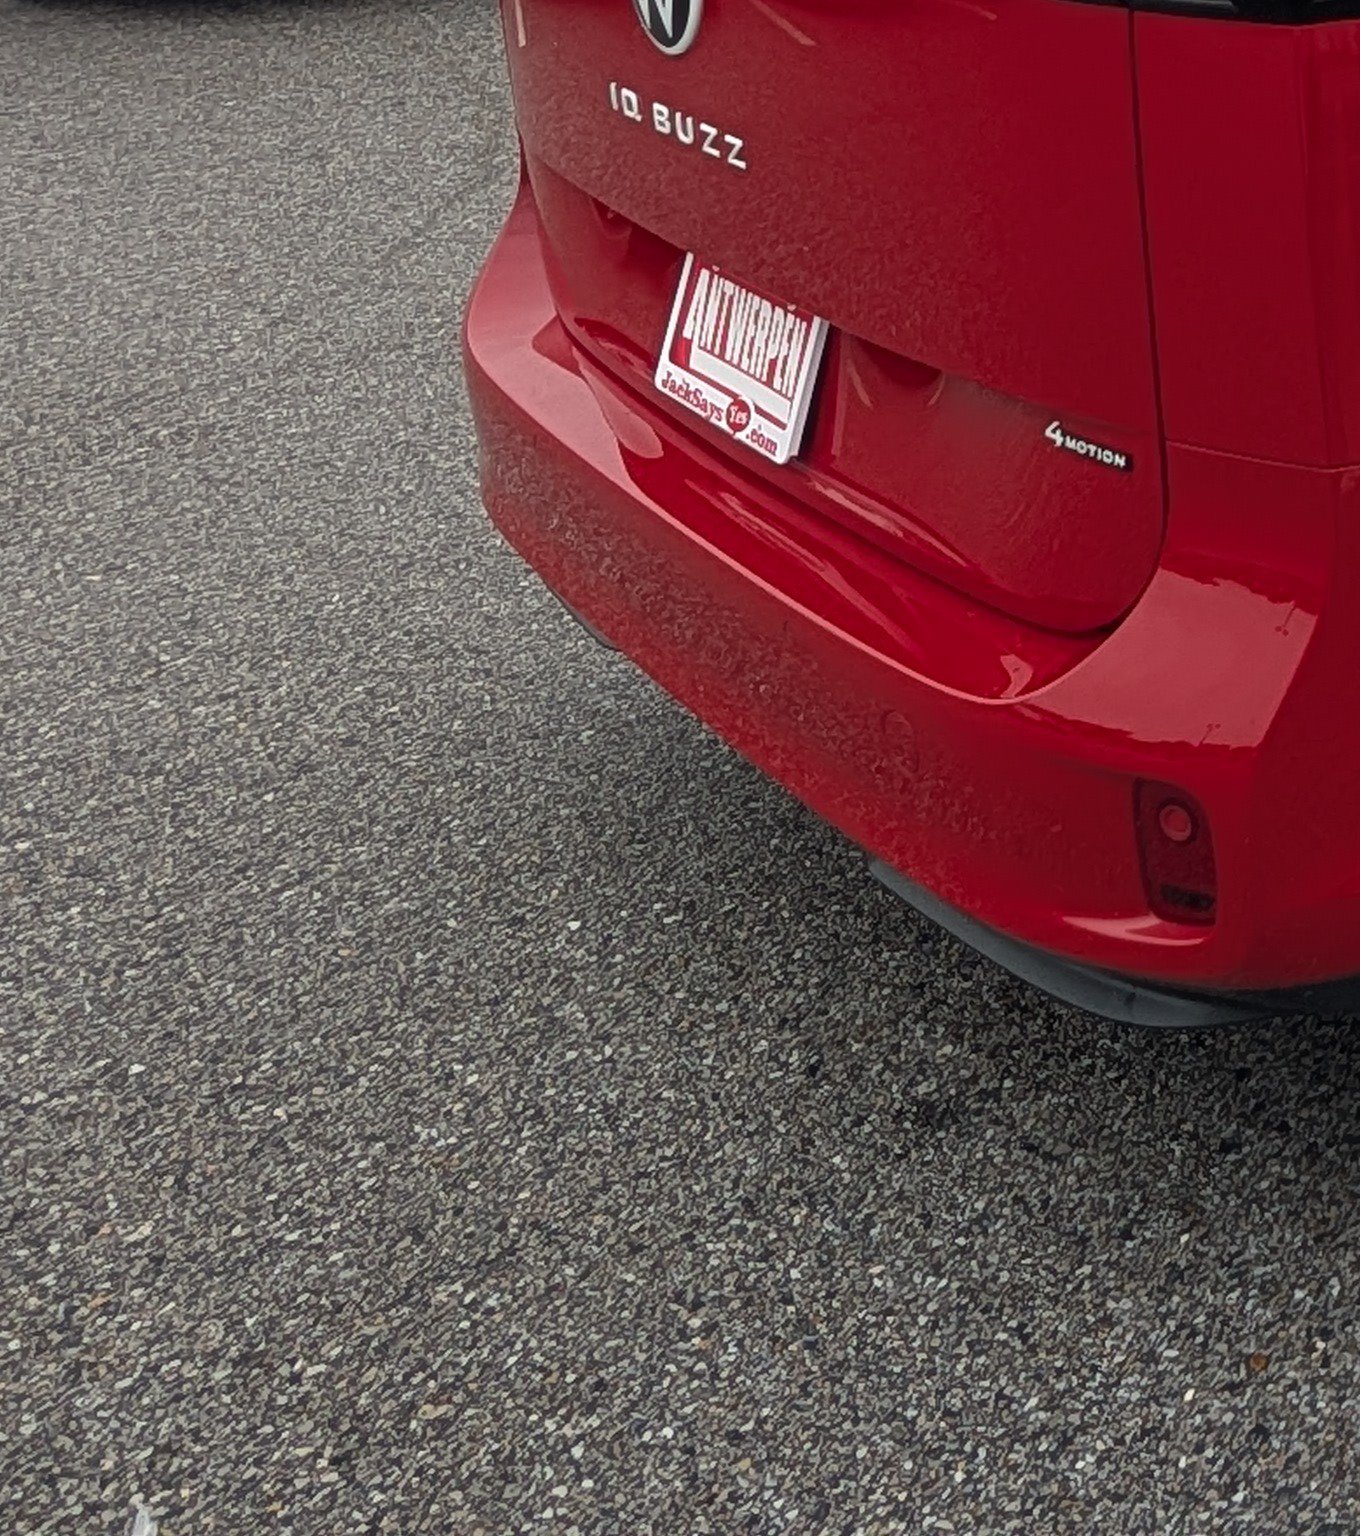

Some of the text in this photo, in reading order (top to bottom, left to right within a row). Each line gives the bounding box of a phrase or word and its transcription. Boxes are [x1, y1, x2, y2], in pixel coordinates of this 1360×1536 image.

[652, 101, 746, 170] BUZZ
[683, 267, 808, 398] ANTWERPEN
[661, 370, 724, 422] JackSays
[1044, 420, 1126, 468] 4MOTION
